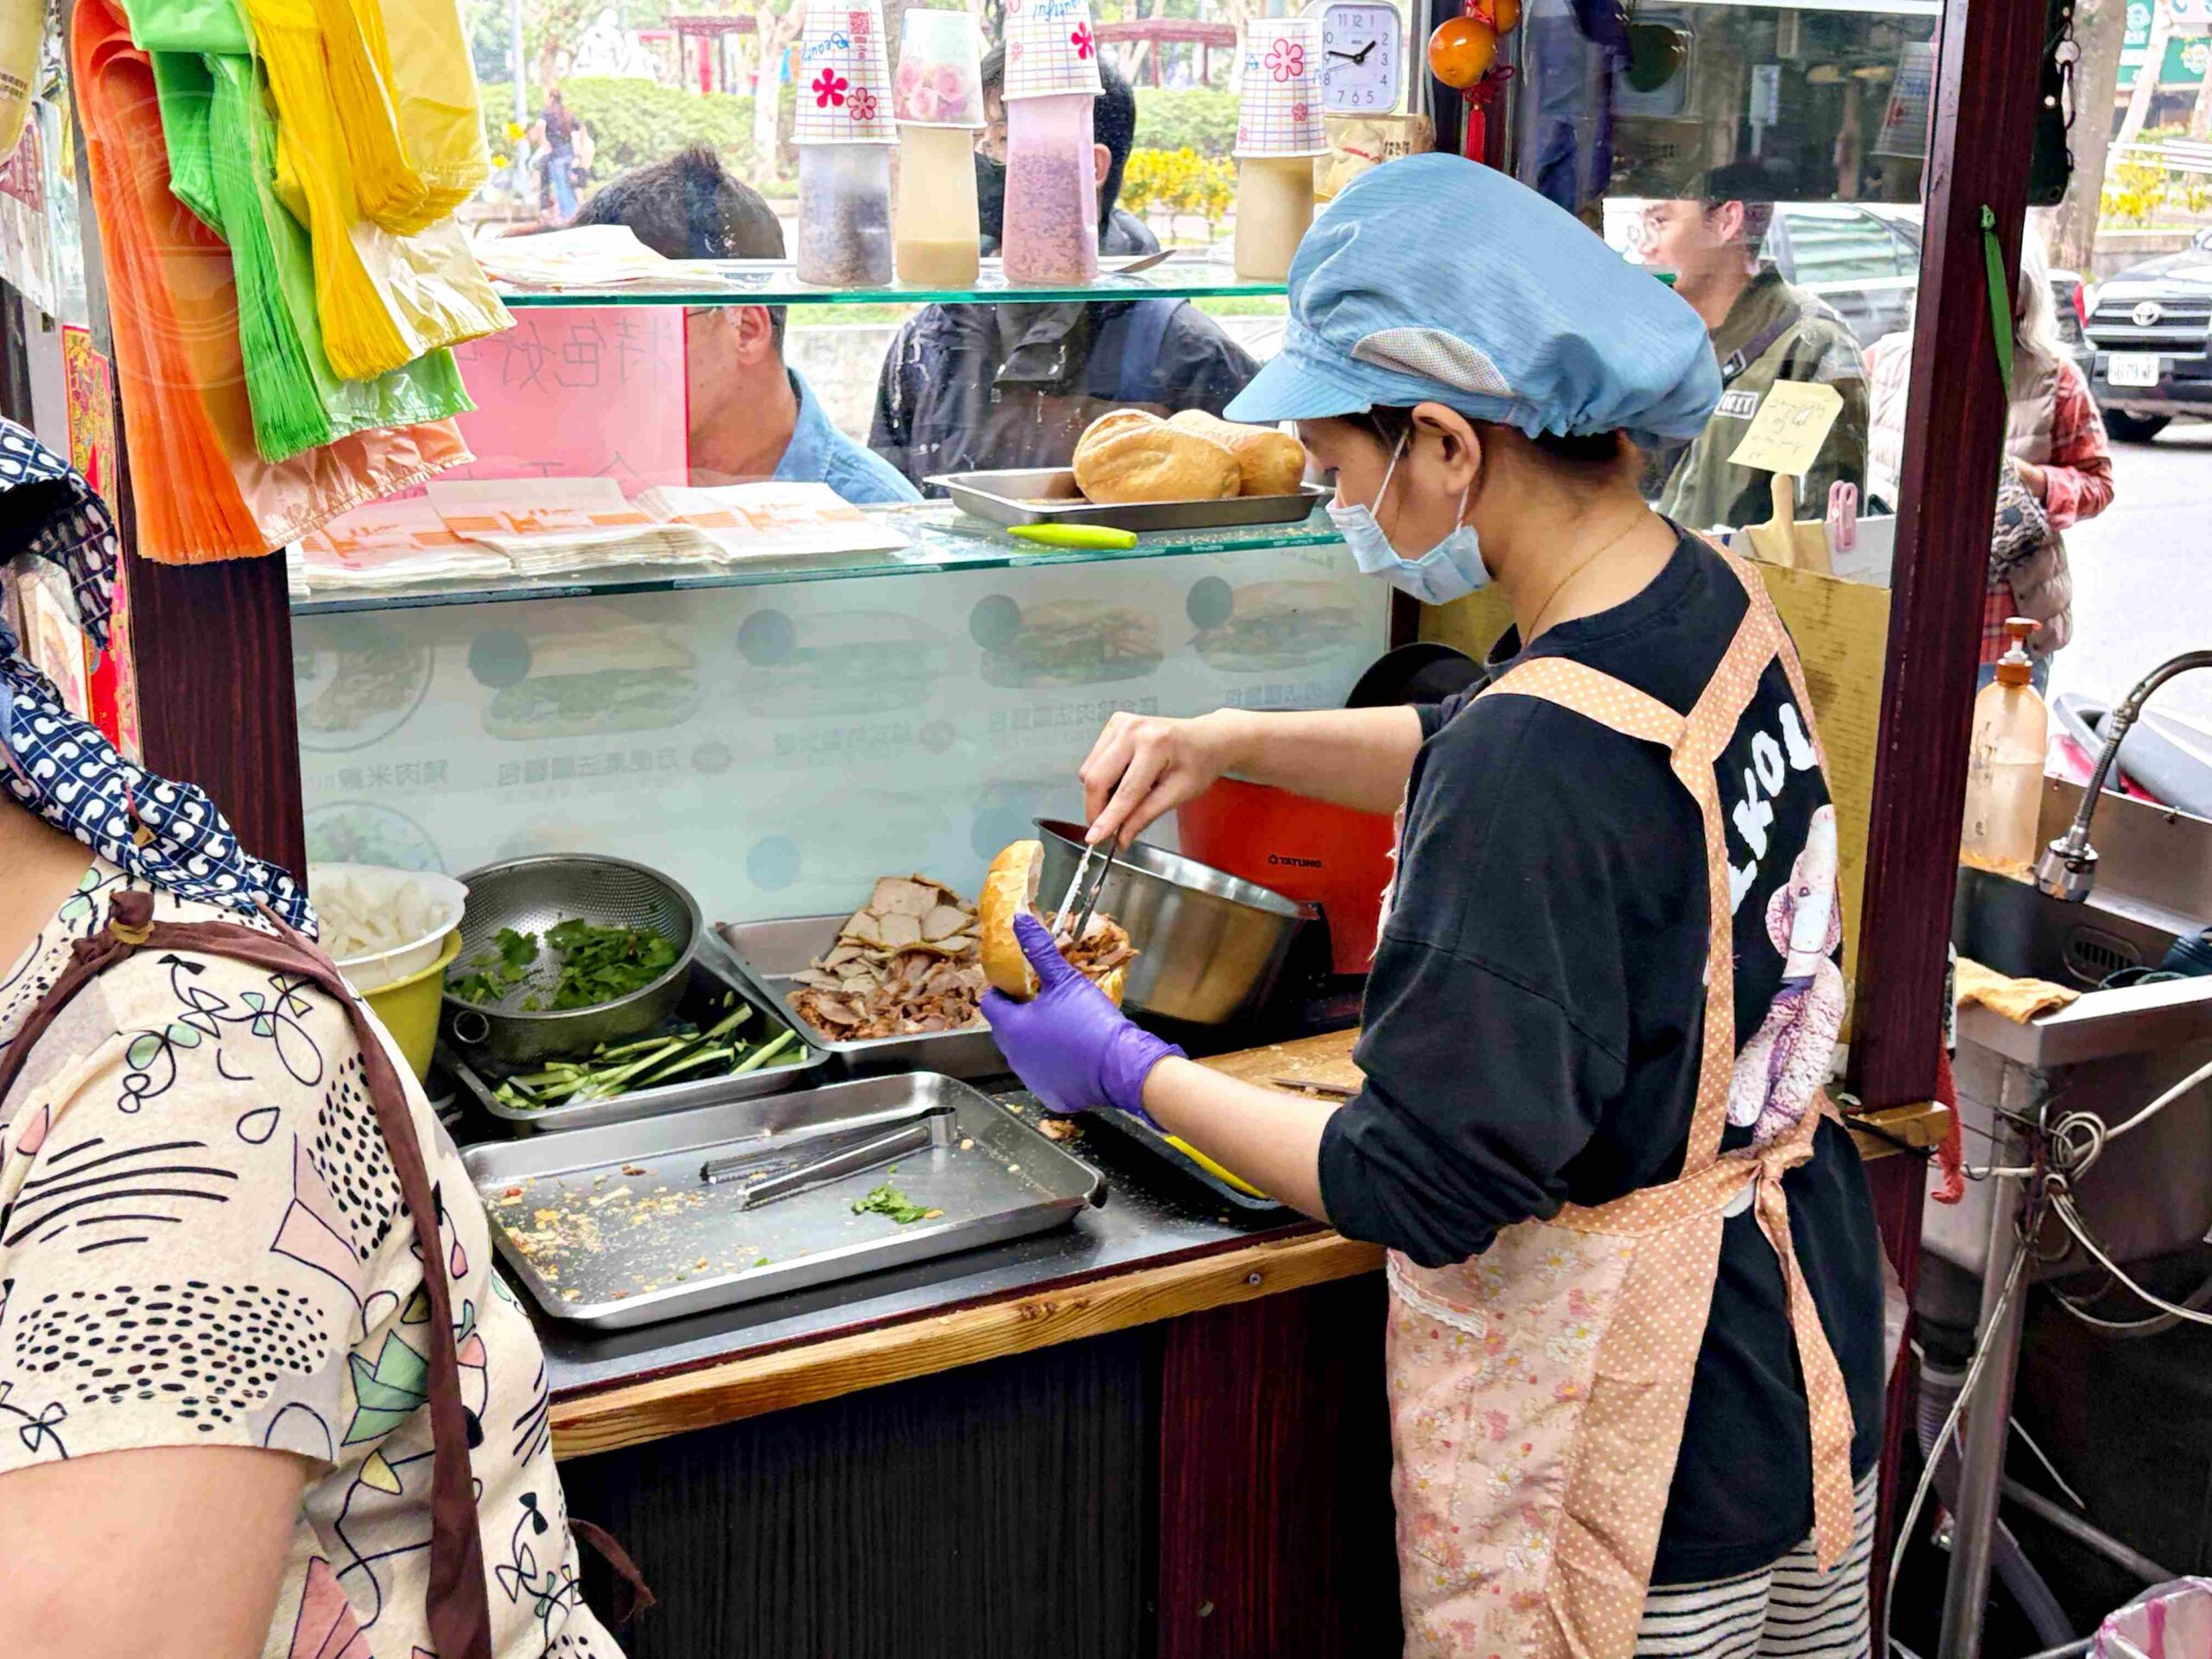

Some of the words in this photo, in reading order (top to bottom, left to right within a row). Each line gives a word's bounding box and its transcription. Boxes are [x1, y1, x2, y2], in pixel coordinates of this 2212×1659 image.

[1338, 14, 1347, 27] 11
[1352, 14, 1363, 27] 12
[1370, 14, 1375, 27] 1
[1381, 34, 1389, 47] 2
[1381, 53, 1389, 67] 3
[1323, 72, 1332, 86] 8
[1380, 74, 1389, 87] 4
[1338, 91, 1345, 105] 7
[1352, 91, 1360, 105] 6
[1366, 91, 1375, 105] 5
[1279, 856, 1322, 868] TATUNG
